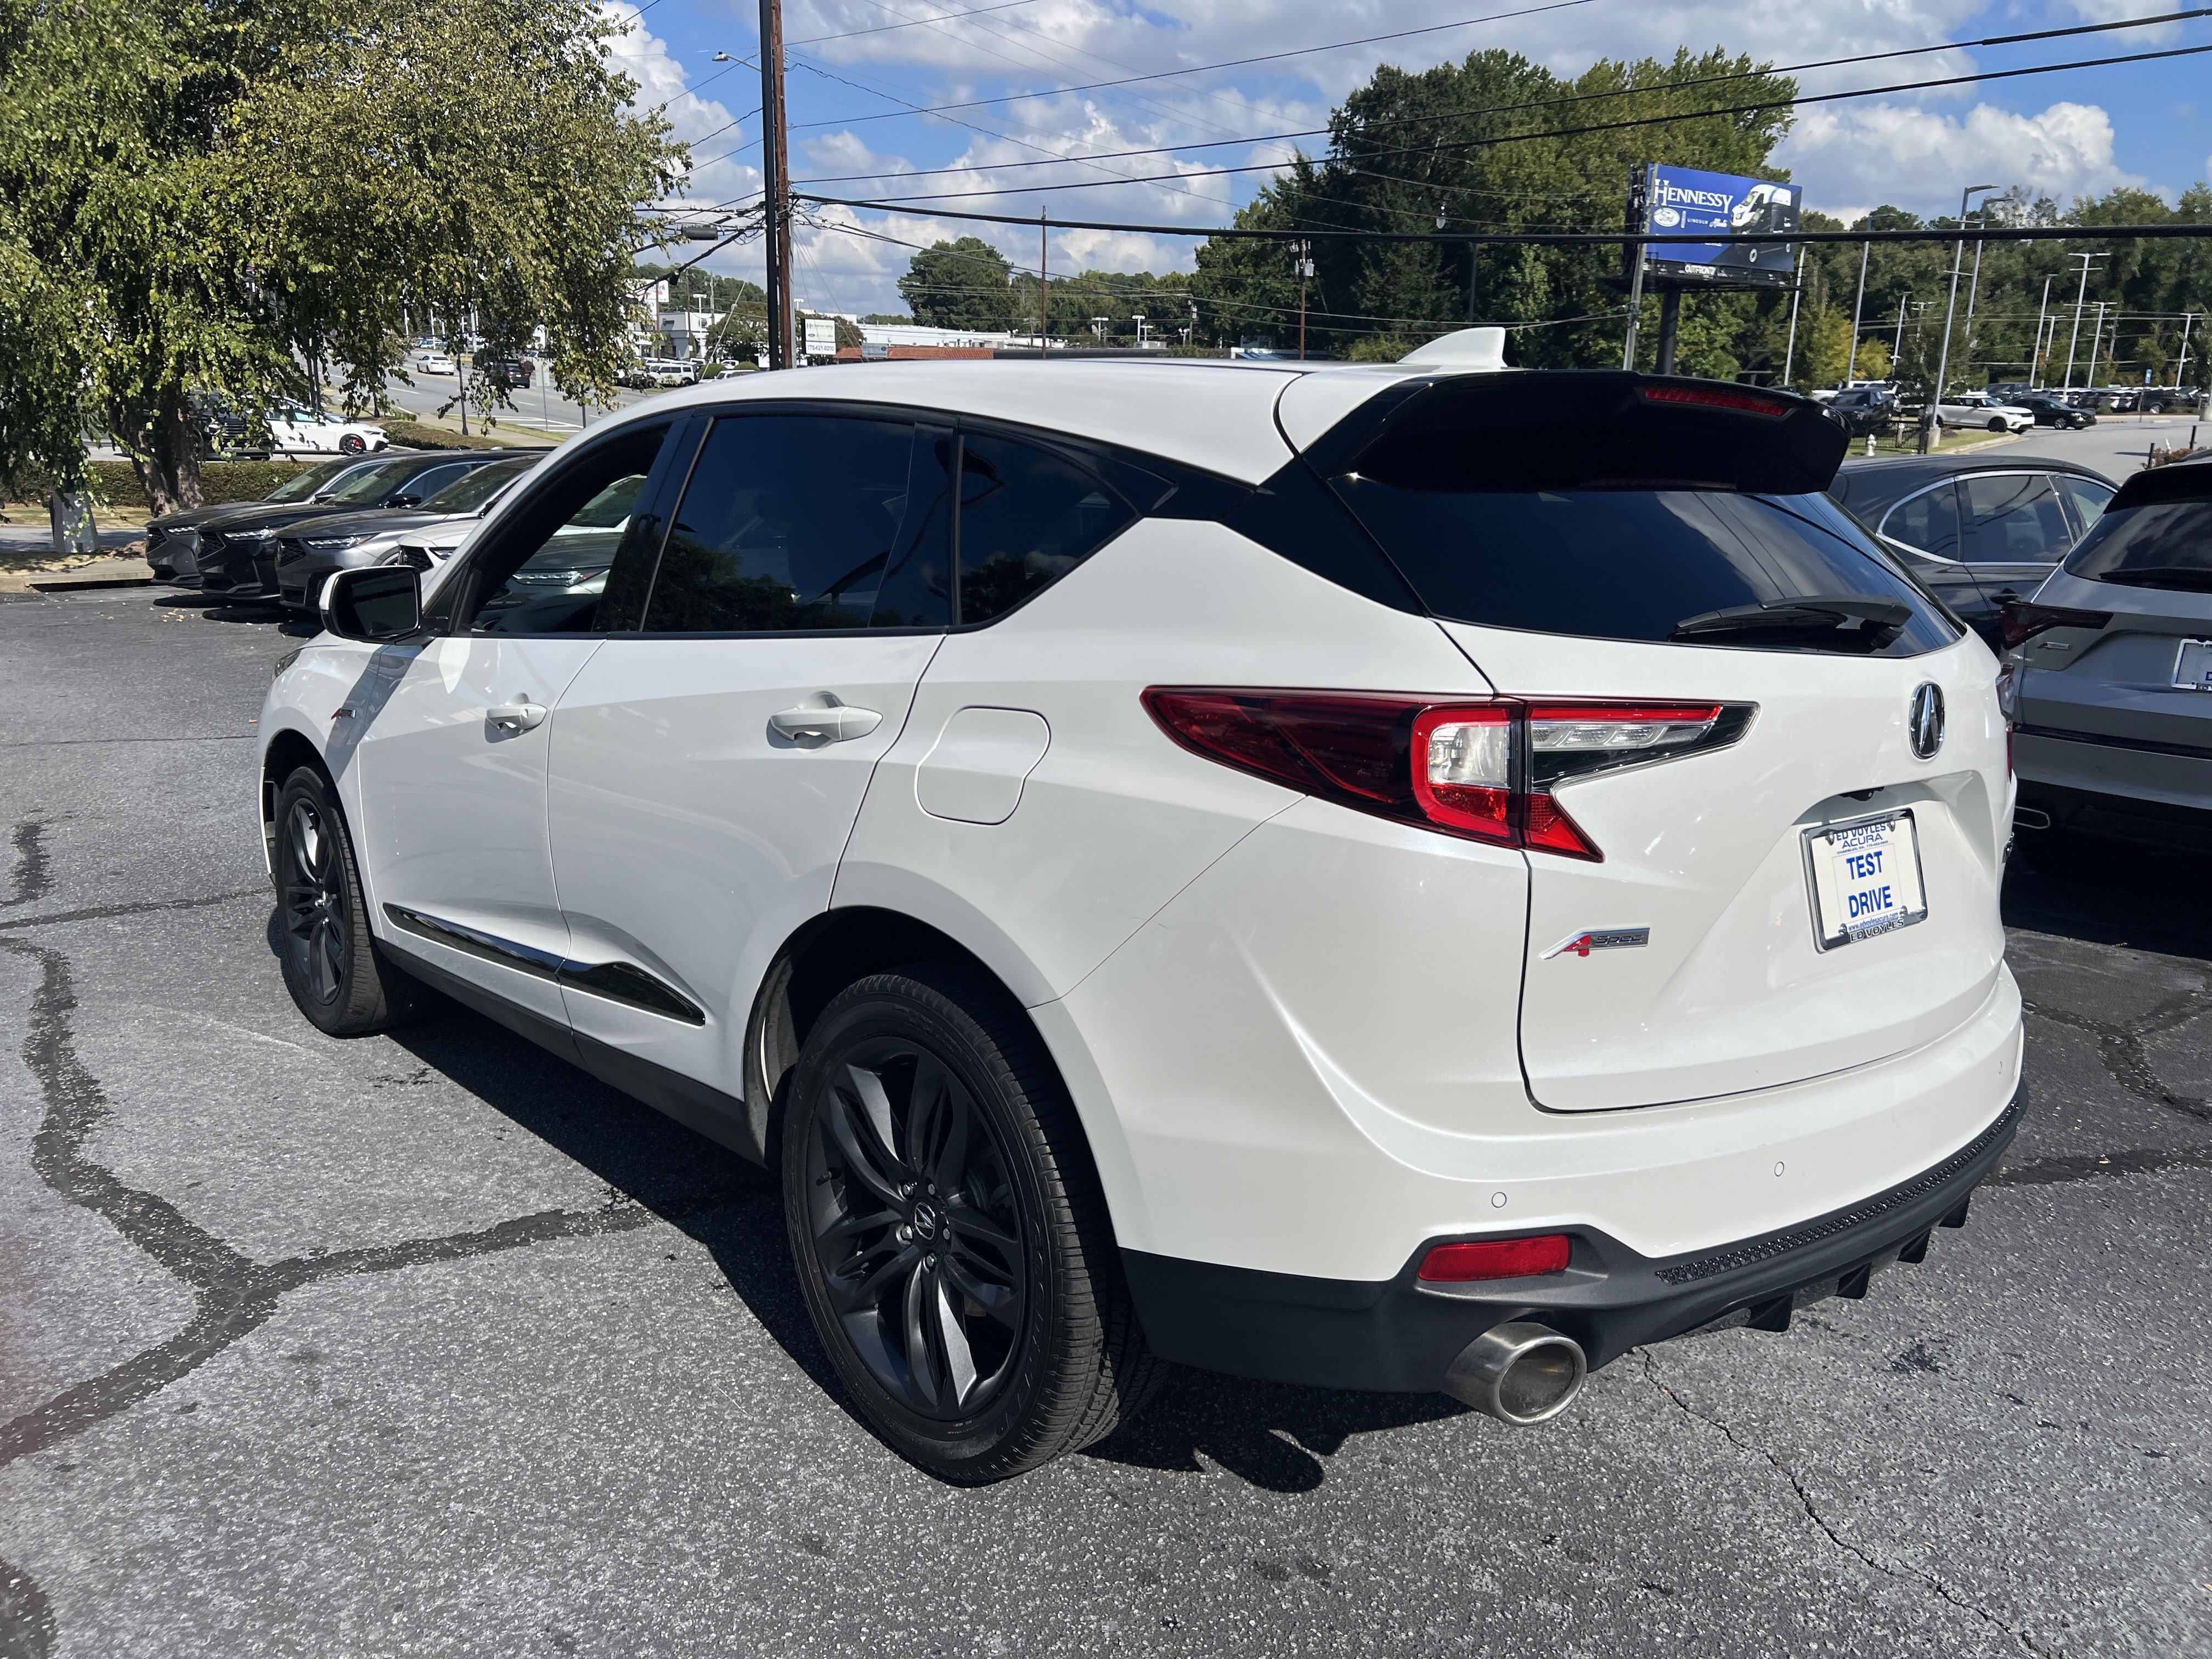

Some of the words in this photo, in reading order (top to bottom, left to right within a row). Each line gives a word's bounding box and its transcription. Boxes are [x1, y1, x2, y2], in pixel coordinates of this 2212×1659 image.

[1653, 179, 1734, 214] HENNESSY
[1836, 831, 1848, 840] ED
[1851, 823, 1886, 837] VOYLES
[1842, 833, 1883, 849] ACURA
[1846, 850, 1882, 880] TEST
[1848, 885, 1893, 918] DRIVE
[1851, 930, 1864, 941] ED
[1865, 919, 1904, 936] VOYLES
